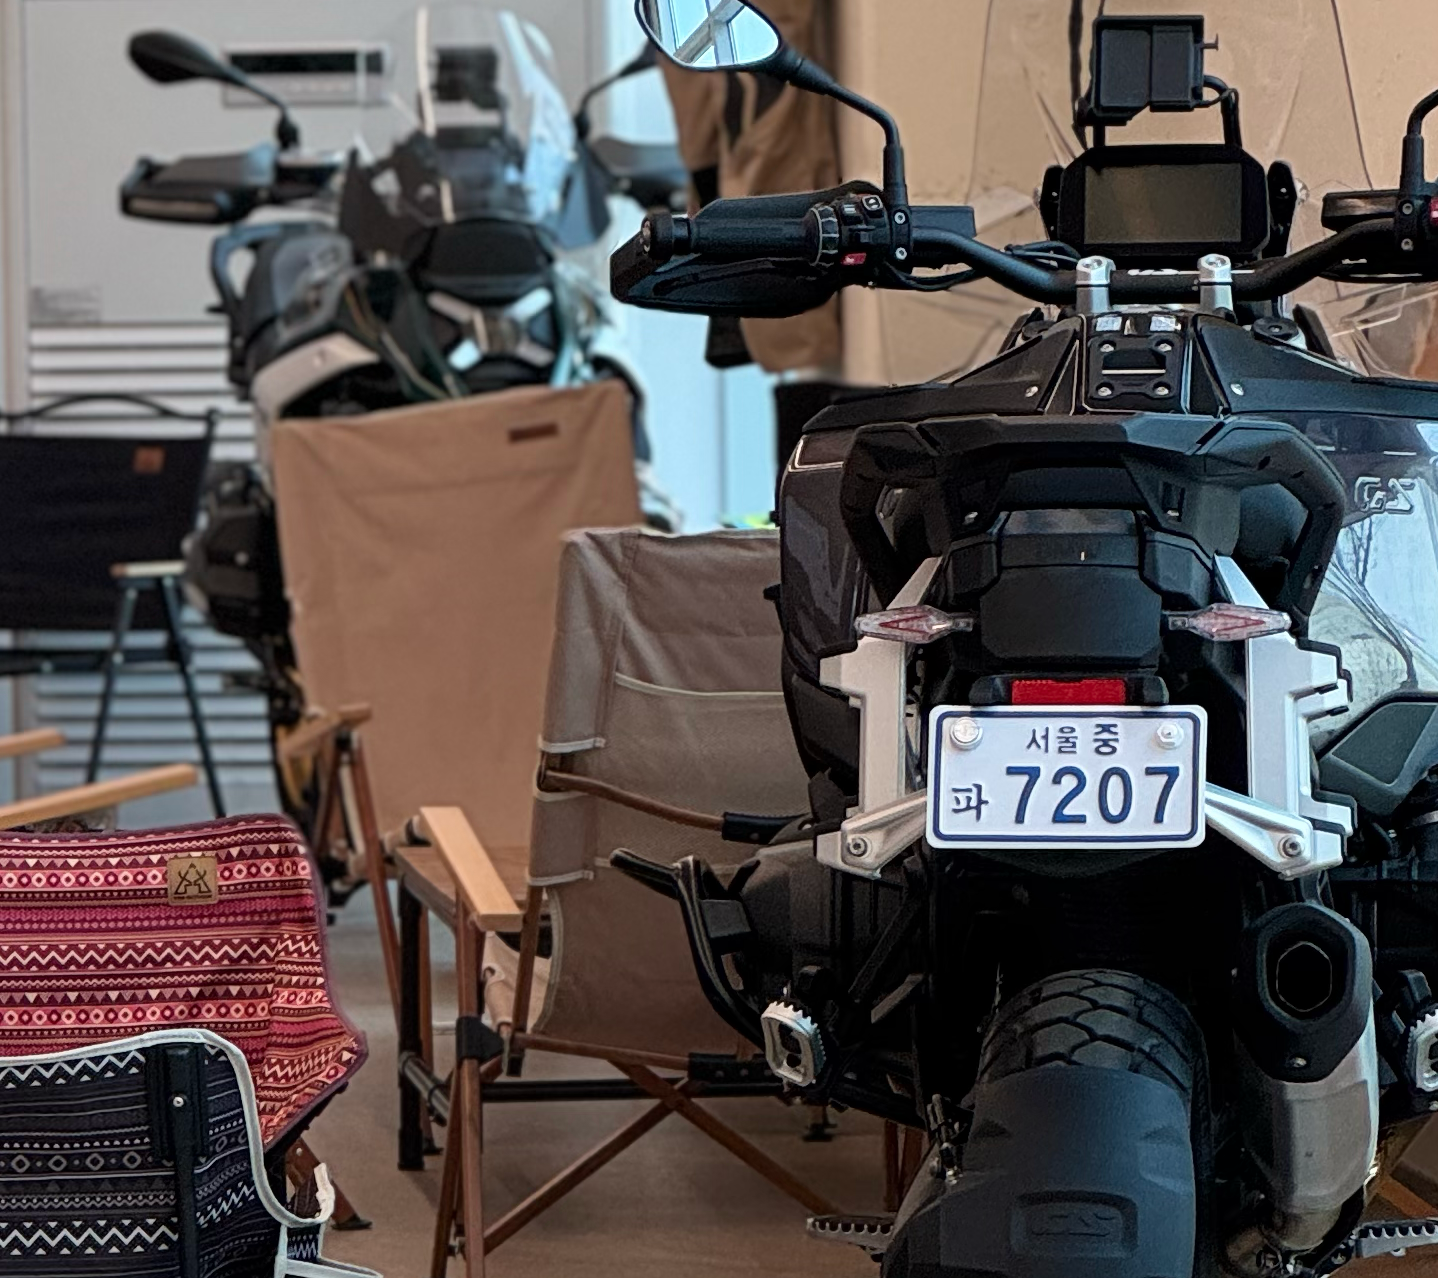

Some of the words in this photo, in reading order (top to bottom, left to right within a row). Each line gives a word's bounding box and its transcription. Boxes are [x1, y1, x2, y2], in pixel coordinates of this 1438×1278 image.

[1026, 725, 1079, 755] 서울
[1092, 723, 1120, 756] 중
[951, 783, 989, 822] 파
[1005, 765, 1181, 824] 7207
